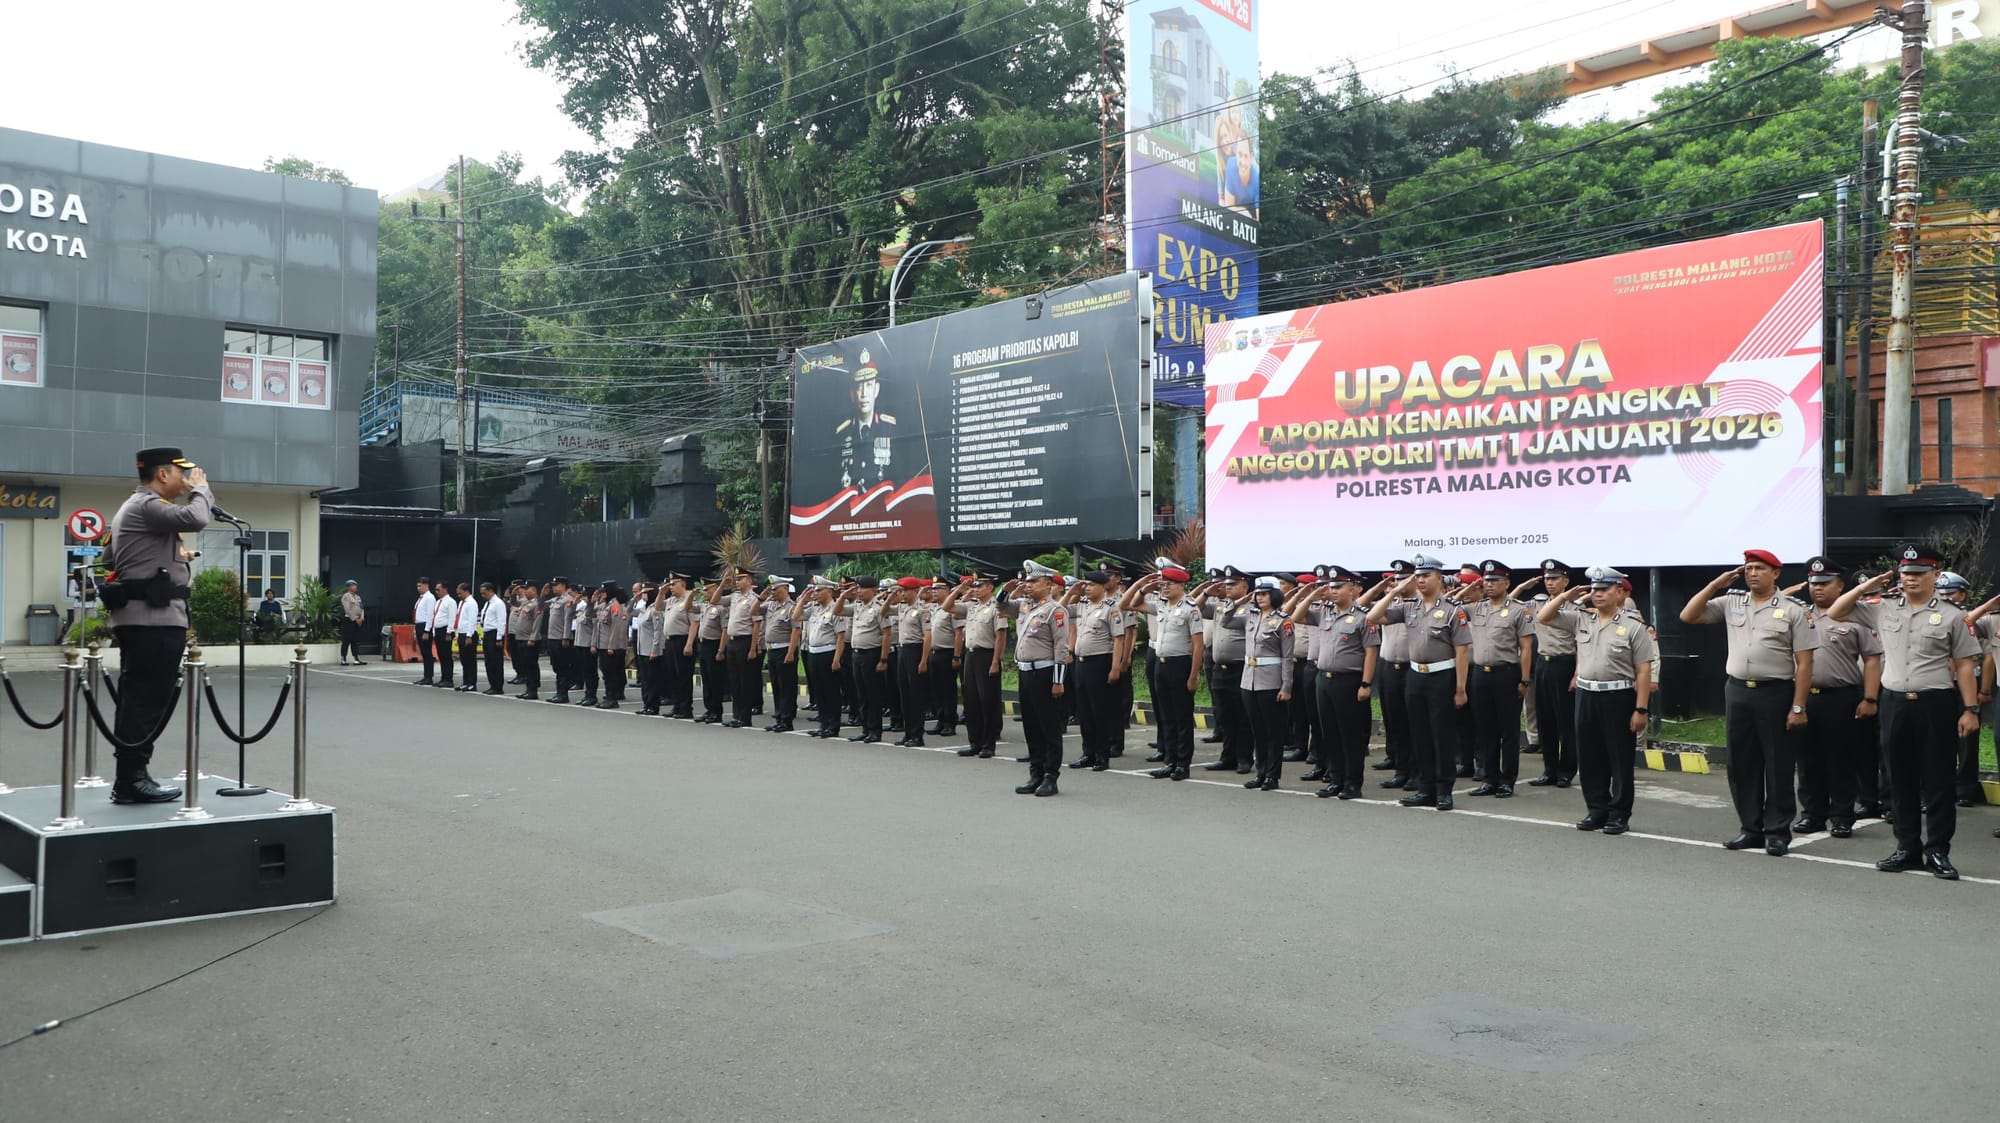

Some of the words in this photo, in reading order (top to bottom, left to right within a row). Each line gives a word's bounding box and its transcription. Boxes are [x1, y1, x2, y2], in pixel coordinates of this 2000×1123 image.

[7, 228, 88, 259] KOTA
[1181, 199, 1224, 231] MALANG
[1232, 219, 1257, 245] BATU
[1157, 232, 1239, 301] EXPO
[1614, 267, 1684, 287] POLRESTA
[1687, 256, 1750, 276] MALANG
[1753, 250, 1795, 266] KOTA
[1153, 291, 1239, 348] RUM
[952, 353, 961, 369] 16
[962, 345, 999, 367] PROGRAM
[1000, 337, 1042, 360] PRIORITAS
[1043, 330, 1079, 352] KAPOLRI
[1334, 338, 1615, 410] UPACARA
[1258, 415, 1381, 447] LAPORAN
[1386, 399, 1542, 435] KENAIKAN
[1551, 382, 1726, 421] PANGKAT
[1226, 446, 1350, 478] ANGGOTA
[1356, 440, 1433, 469] POLRI
[1439, 434, 1504, 462] TMT
[1508, 432, 1520, 457] 1
[1528, 420, 1681, 456] JANUARI
[1690, 411, 1784, 444] 2026
[1336, 476, 1442, 498] POLRESTA
[1448, 468, 1553, 493] MALANG
[1558, 464, 1632, 487] KOTA
[1404, 536, 1446, 549] Malang,
[1449, 536, 1459, 546] 31
[1461, 535, 1518, 546] Desember
[1521, 534, 1549, 544] 2025
